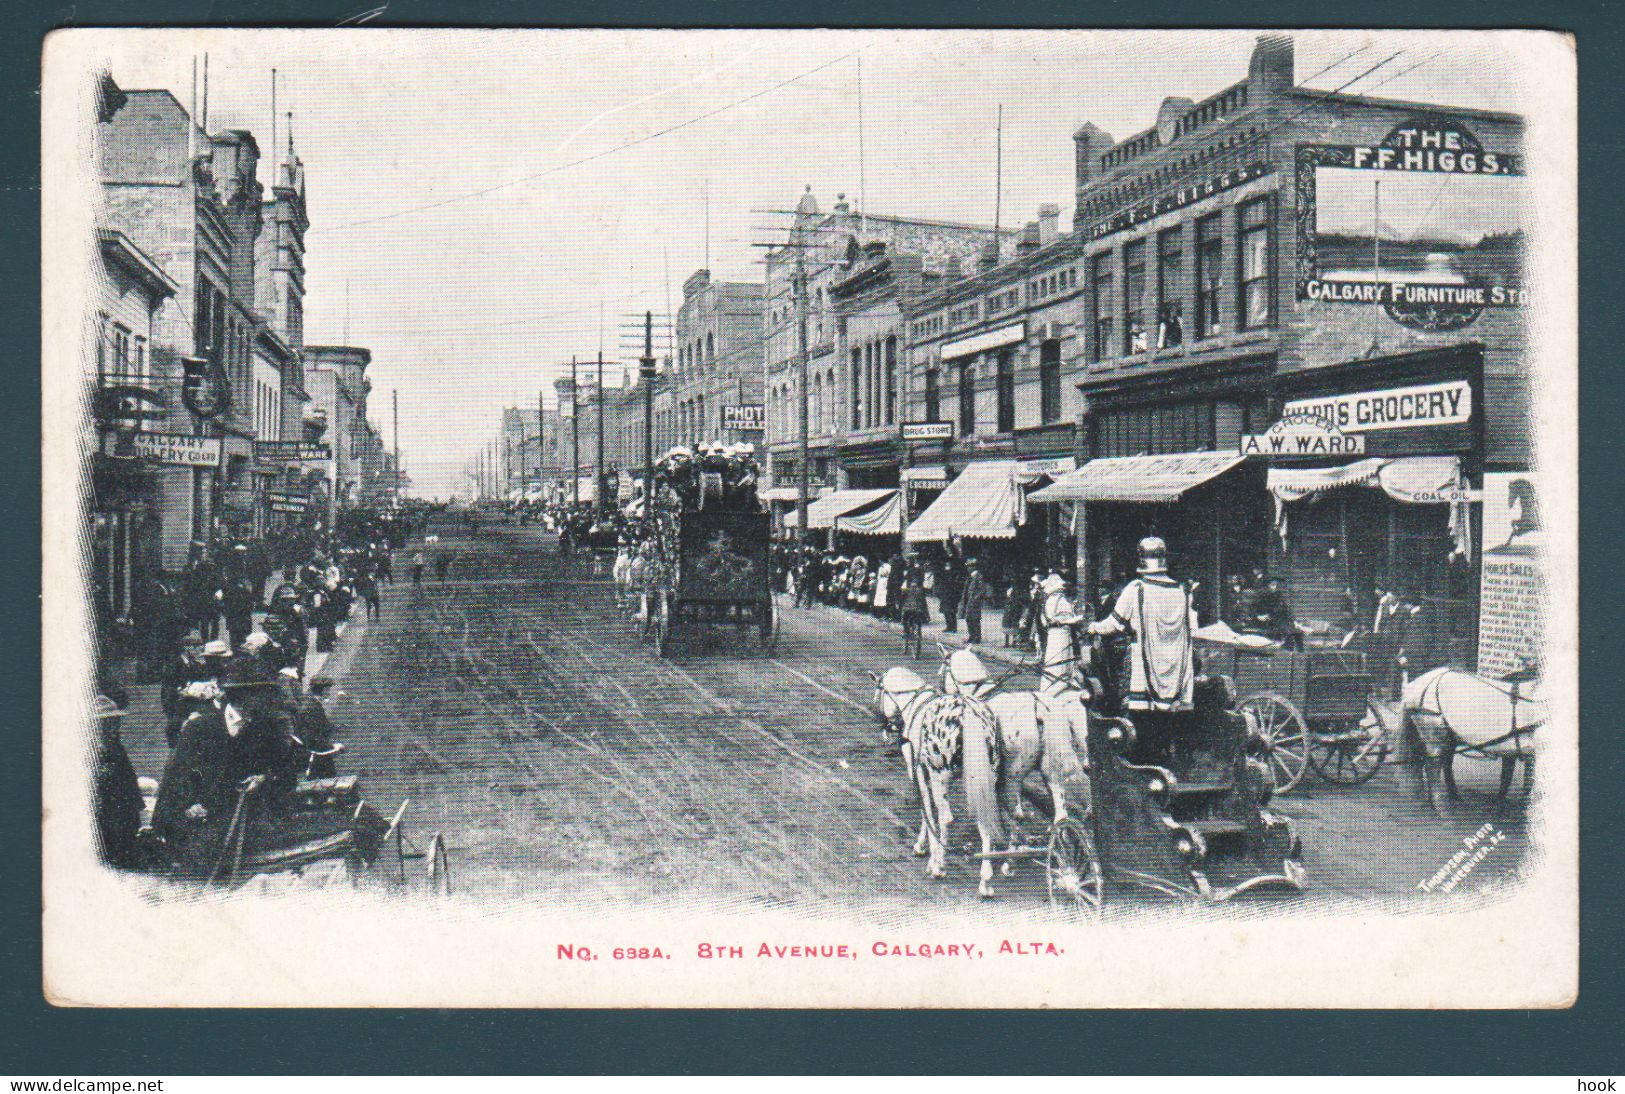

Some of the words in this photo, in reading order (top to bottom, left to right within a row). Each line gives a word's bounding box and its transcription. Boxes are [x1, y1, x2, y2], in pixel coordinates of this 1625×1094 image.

[1398, 129, 1462, 149] THE
[1307, 280, 1385, 300] CALGARY
[1391, 283, 1485, 303] FURNITURE
[1356, 388, 1463, 424] GROCERY
[904, 427, 925, 436] DRUG
[926, 426, 950, 435] STORE
[1296, 434, 1362, 453] WARD.
[1413, 490, 1446, 501] COAL
[1450, 489, 1470, 500] OIL
